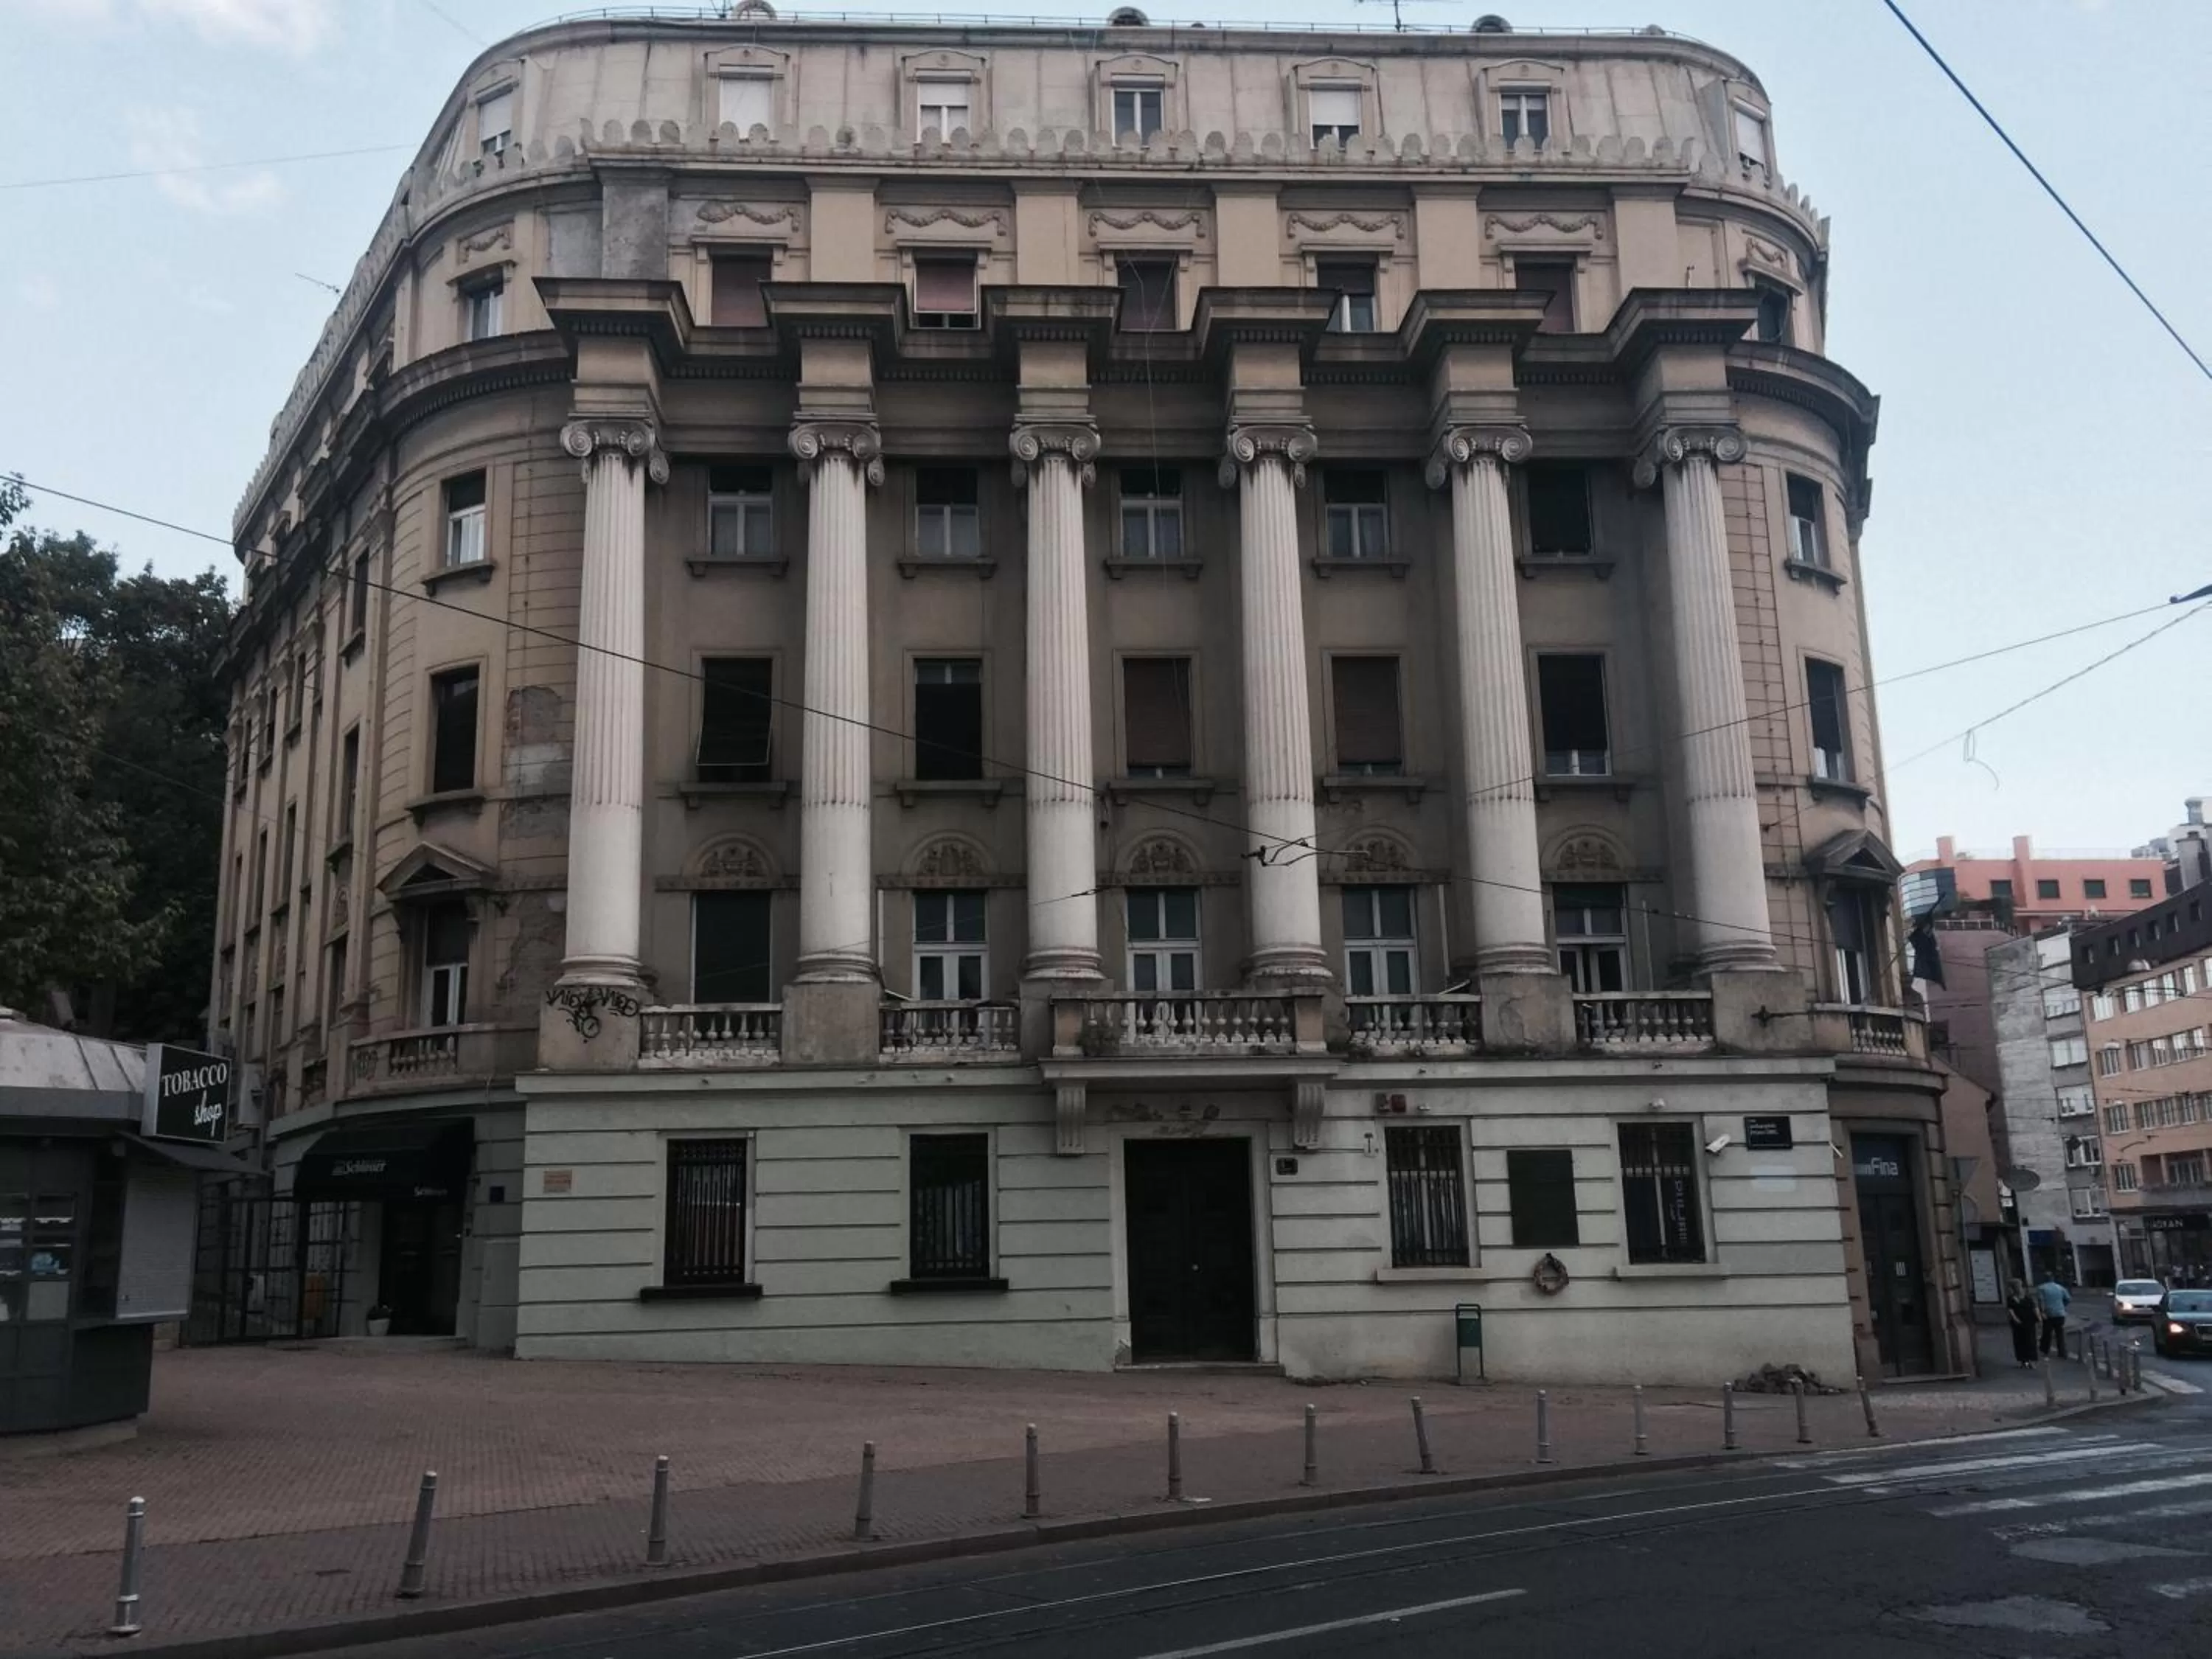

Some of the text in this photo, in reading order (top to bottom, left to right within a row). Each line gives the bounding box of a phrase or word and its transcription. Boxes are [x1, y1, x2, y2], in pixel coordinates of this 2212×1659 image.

[161, 1062, 228, 1097] TOBACCO
[194, 1089, 223, 1138] shop
[1871, 1157, 1899, 1176] Fina
